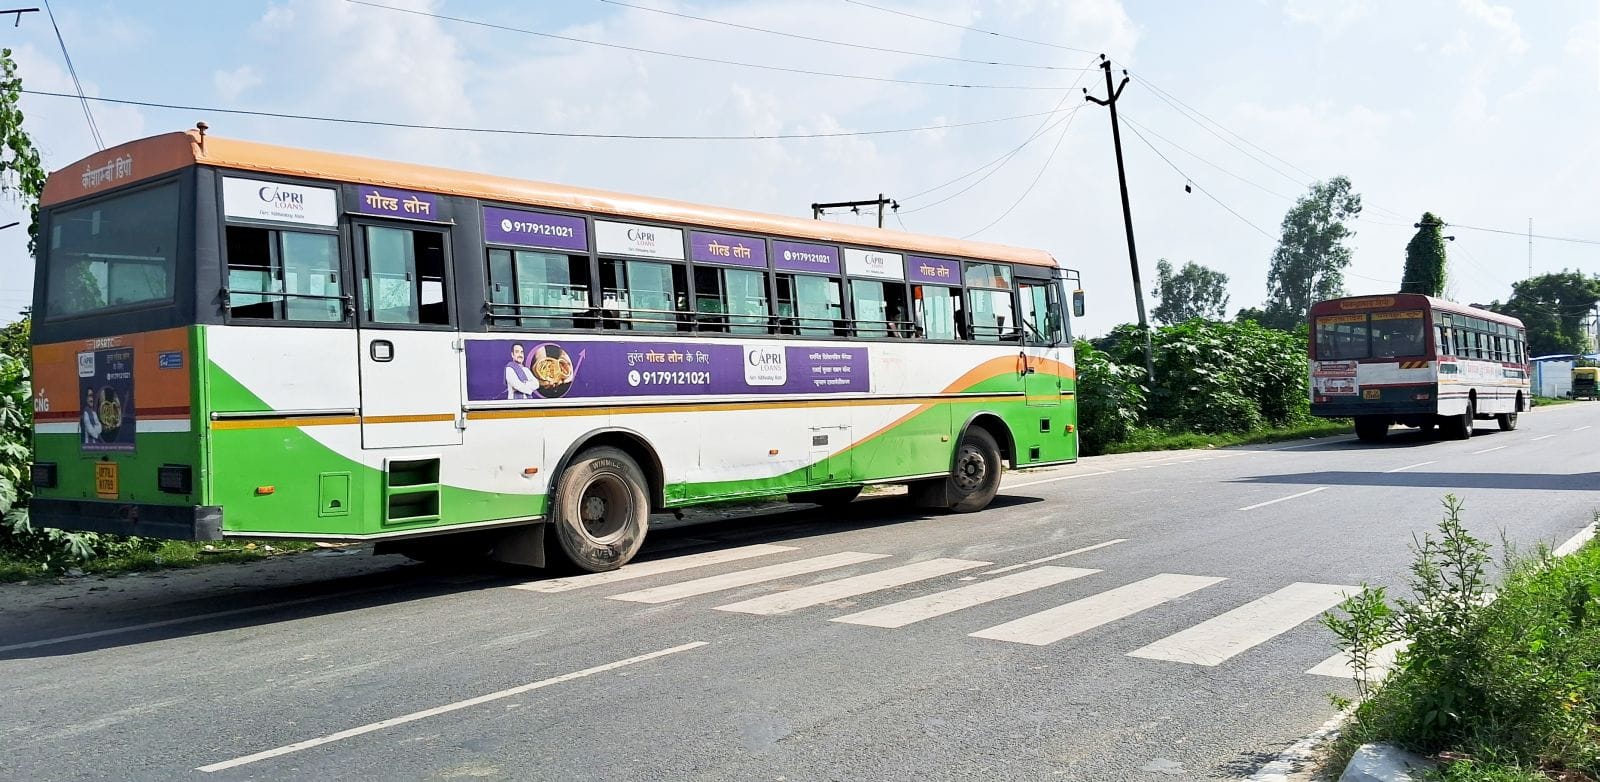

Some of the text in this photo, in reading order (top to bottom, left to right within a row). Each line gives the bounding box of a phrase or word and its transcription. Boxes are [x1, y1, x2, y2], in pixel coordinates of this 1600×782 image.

[259, 186, 303, 204] CAPRI
[365, 190, 430, 214] गोल्ड लोन
[275, 201, 304, 210] LOANS
[514, 221, 573, 237] 9179121021
[627, 228, 655, 241] CAPRI
[708, 240, 751, 259] गोल्ड लोन
[792, 250, 830, 263] 9179121021
[920, 263, 950, 278] गोल्ड लोन
[627, 350, 709, 366] तुरंत गोल्ड लोन के लिए
[749, 349, 781, 366] CAPRI
[643, 371, 710, 385] 9179121021
[35, 398, 49, 412] CNG
